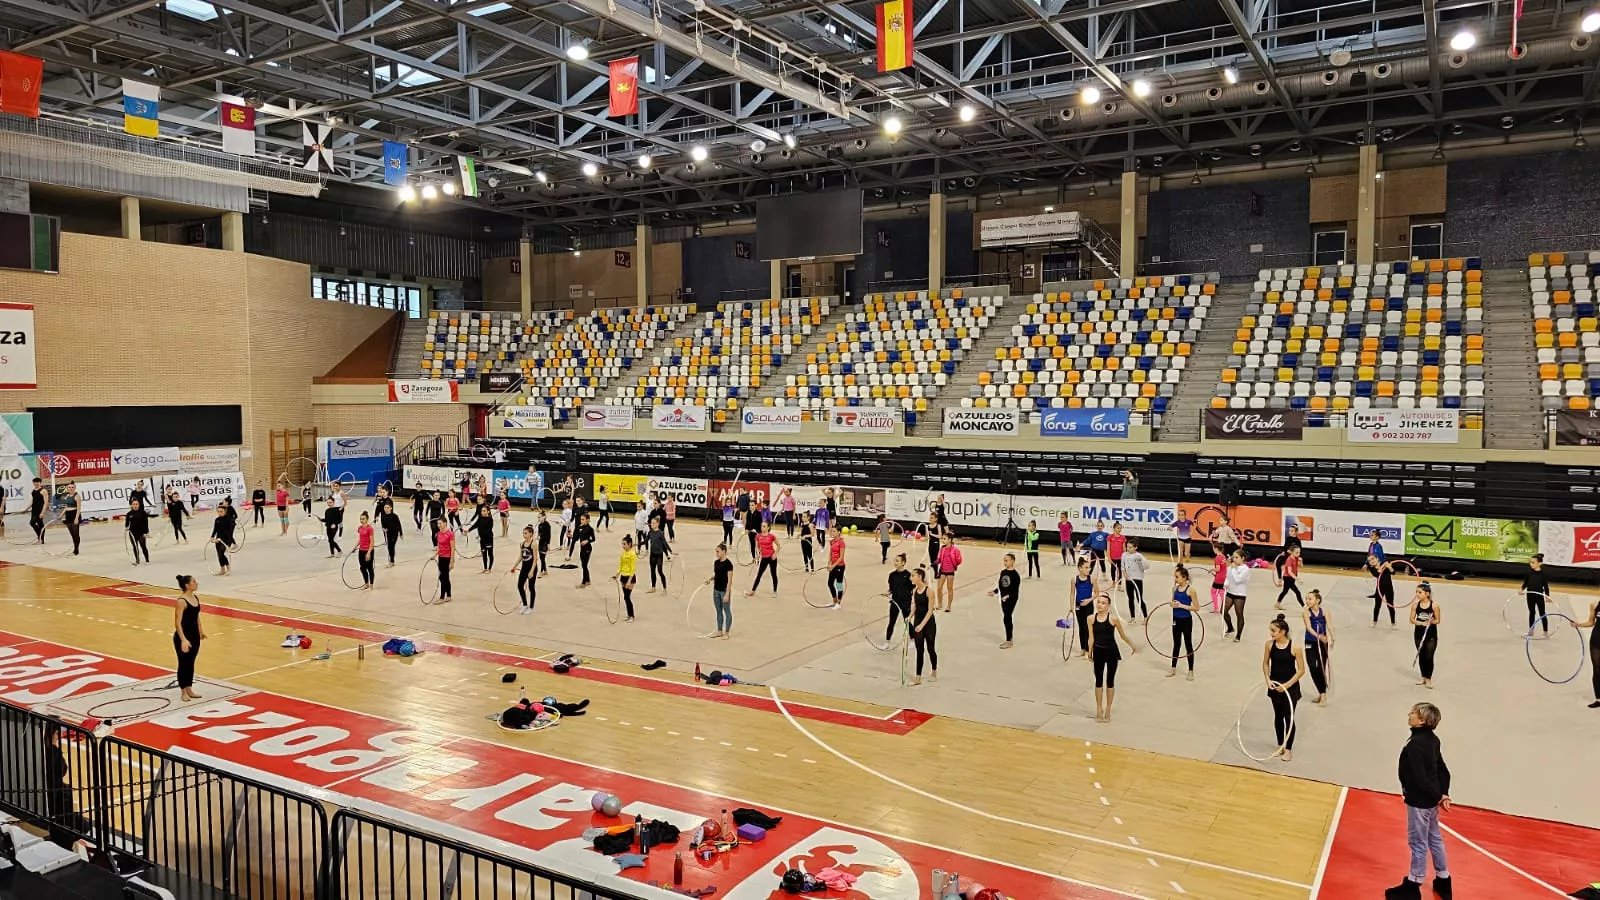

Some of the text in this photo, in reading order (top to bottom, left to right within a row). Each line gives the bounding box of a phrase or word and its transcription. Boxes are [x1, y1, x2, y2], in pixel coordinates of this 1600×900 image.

[736, 243, 744, 256] 13
[616, 254, 625, 265] 12
[512, 261, 520, 273] 11
[411, 384, 443, 393] Zaragoza
[752, 414, 800, 423] SOLANO
[956, 412, 1013, 420] AZULEJOS
[859, 417, 894, 428] CALLIZO
[949, 420, 1014, 432] MONCAYO
[1222, 414, 1284, 433] El Criollo
[1399, 420, 1453, 429] JIMENEZ
[1399, 432, 1416, 440] 202
[1416, 432, 1433, 440] 787
[171, 477, 231, 489] taprama
[658, 482, 698, 491] AZULEJOS
[200, 486, 232, 496] sofás
[719, 487, 765, 504] AMAR
[1317, 523, 1352, 533] Grupo
[1461, 519, 1499, 529] PANELES
[1461, 527, 1499, 537] SOLARES
[1466, 542, 1491, 550] AHORRA
